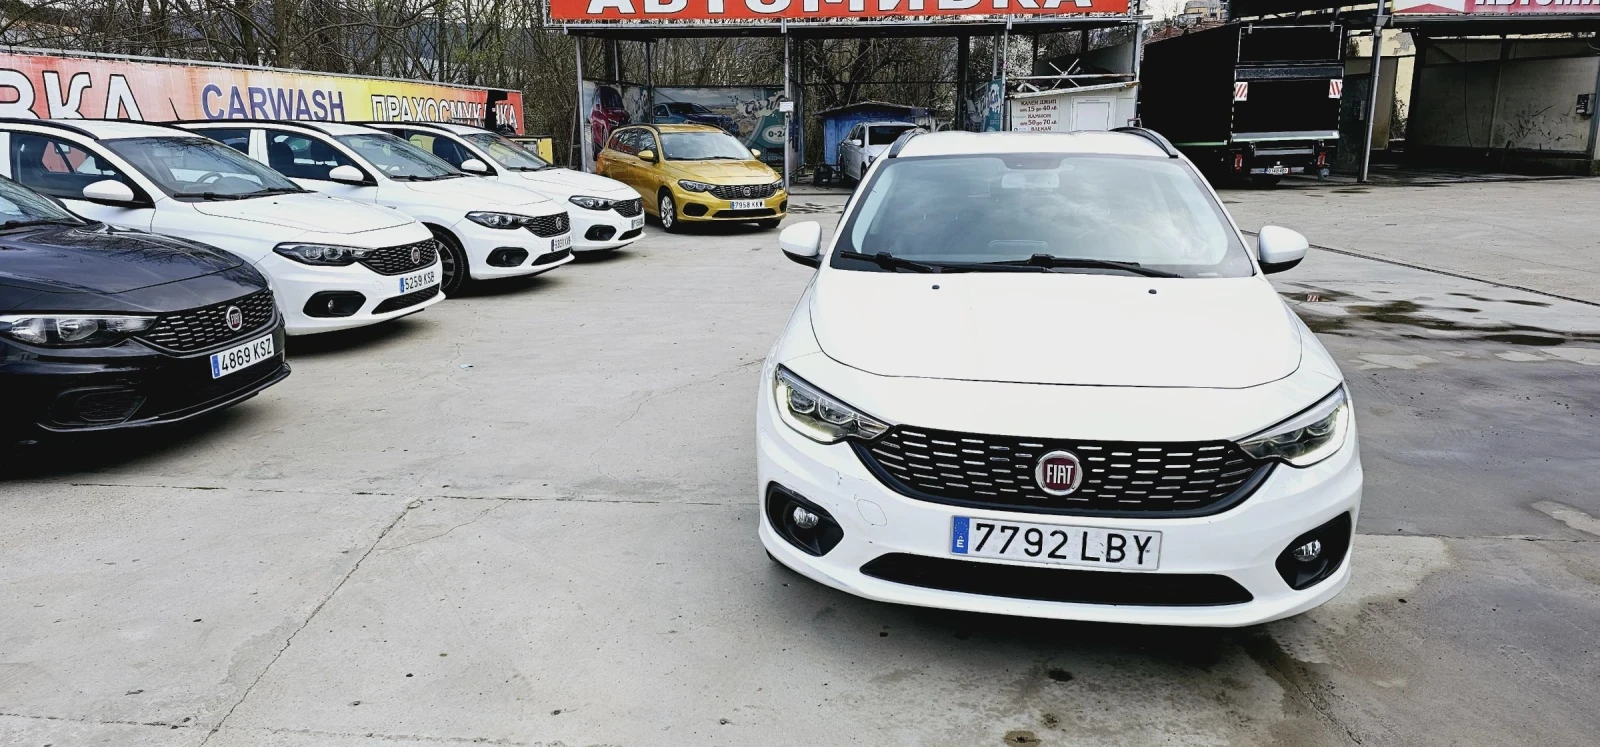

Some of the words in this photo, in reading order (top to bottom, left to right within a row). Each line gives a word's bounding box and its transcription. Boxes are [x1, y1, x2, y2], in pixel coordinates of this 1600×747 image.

[202, 83, 346, 122] CARWASH
[734, 201, 751, 209] 7958
[404, 275, 422, 290] 5259
[423, 271, 435, 285] KSB
[221, 346, 251, 372] 4869
[252, 338, 272, 360] KSZ
[1046, 464, 1074, 485] FIAT
[956, 539, 965, 548] E
[975, 522, 1068, 560] 7792
[1080, 531, 1153, 565] LBY
